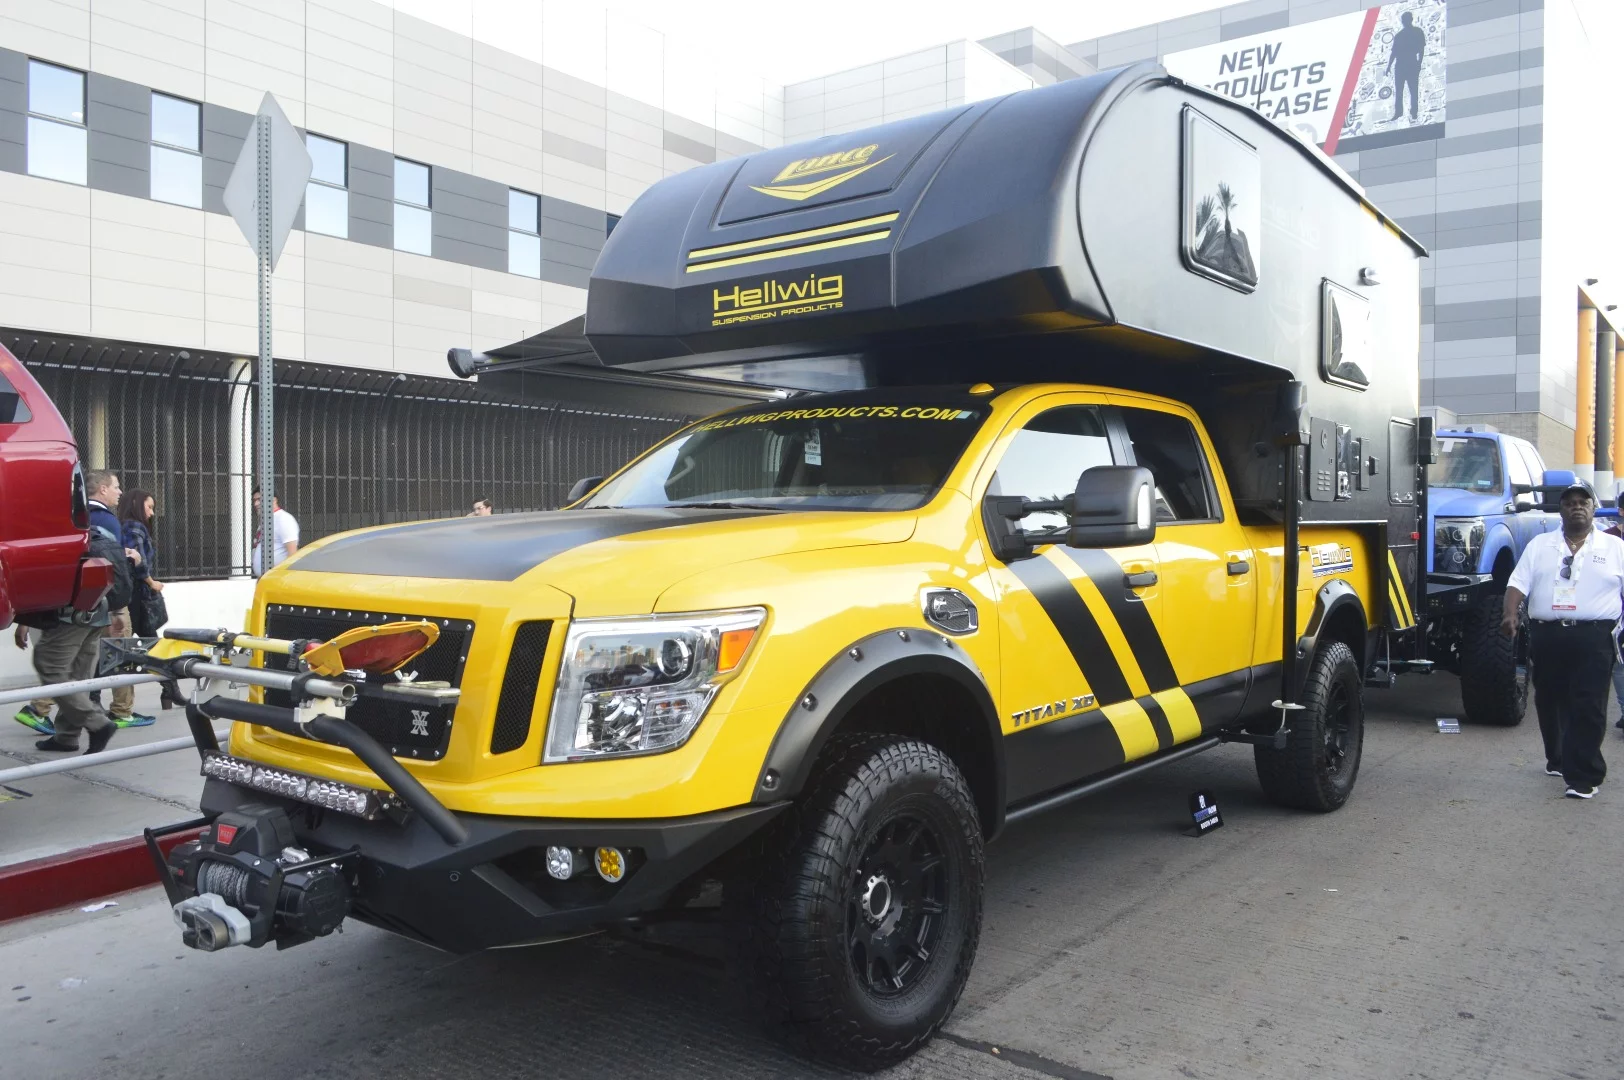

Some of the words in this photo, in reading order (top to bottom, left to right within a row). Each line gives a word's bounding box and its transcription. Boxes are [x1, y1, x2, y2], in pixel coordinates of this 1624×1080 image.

[1219, 41, 1282, 75] NEW
[1203, 61, 1327, 99] ODUCTS
[1250, 87, 1332, 119] CASE
[713, 273, 843, 311] Hellwig
[711, 311, 777, 327] SUSPENSION
[780, 301, 844, 316] PRODUCTS
[689, 405, 963, 434] HELLWIGPRODUCTS.COM
[1011, 699, 1067, 727] TITAN
[1071, 693, 1095, 711] XD
